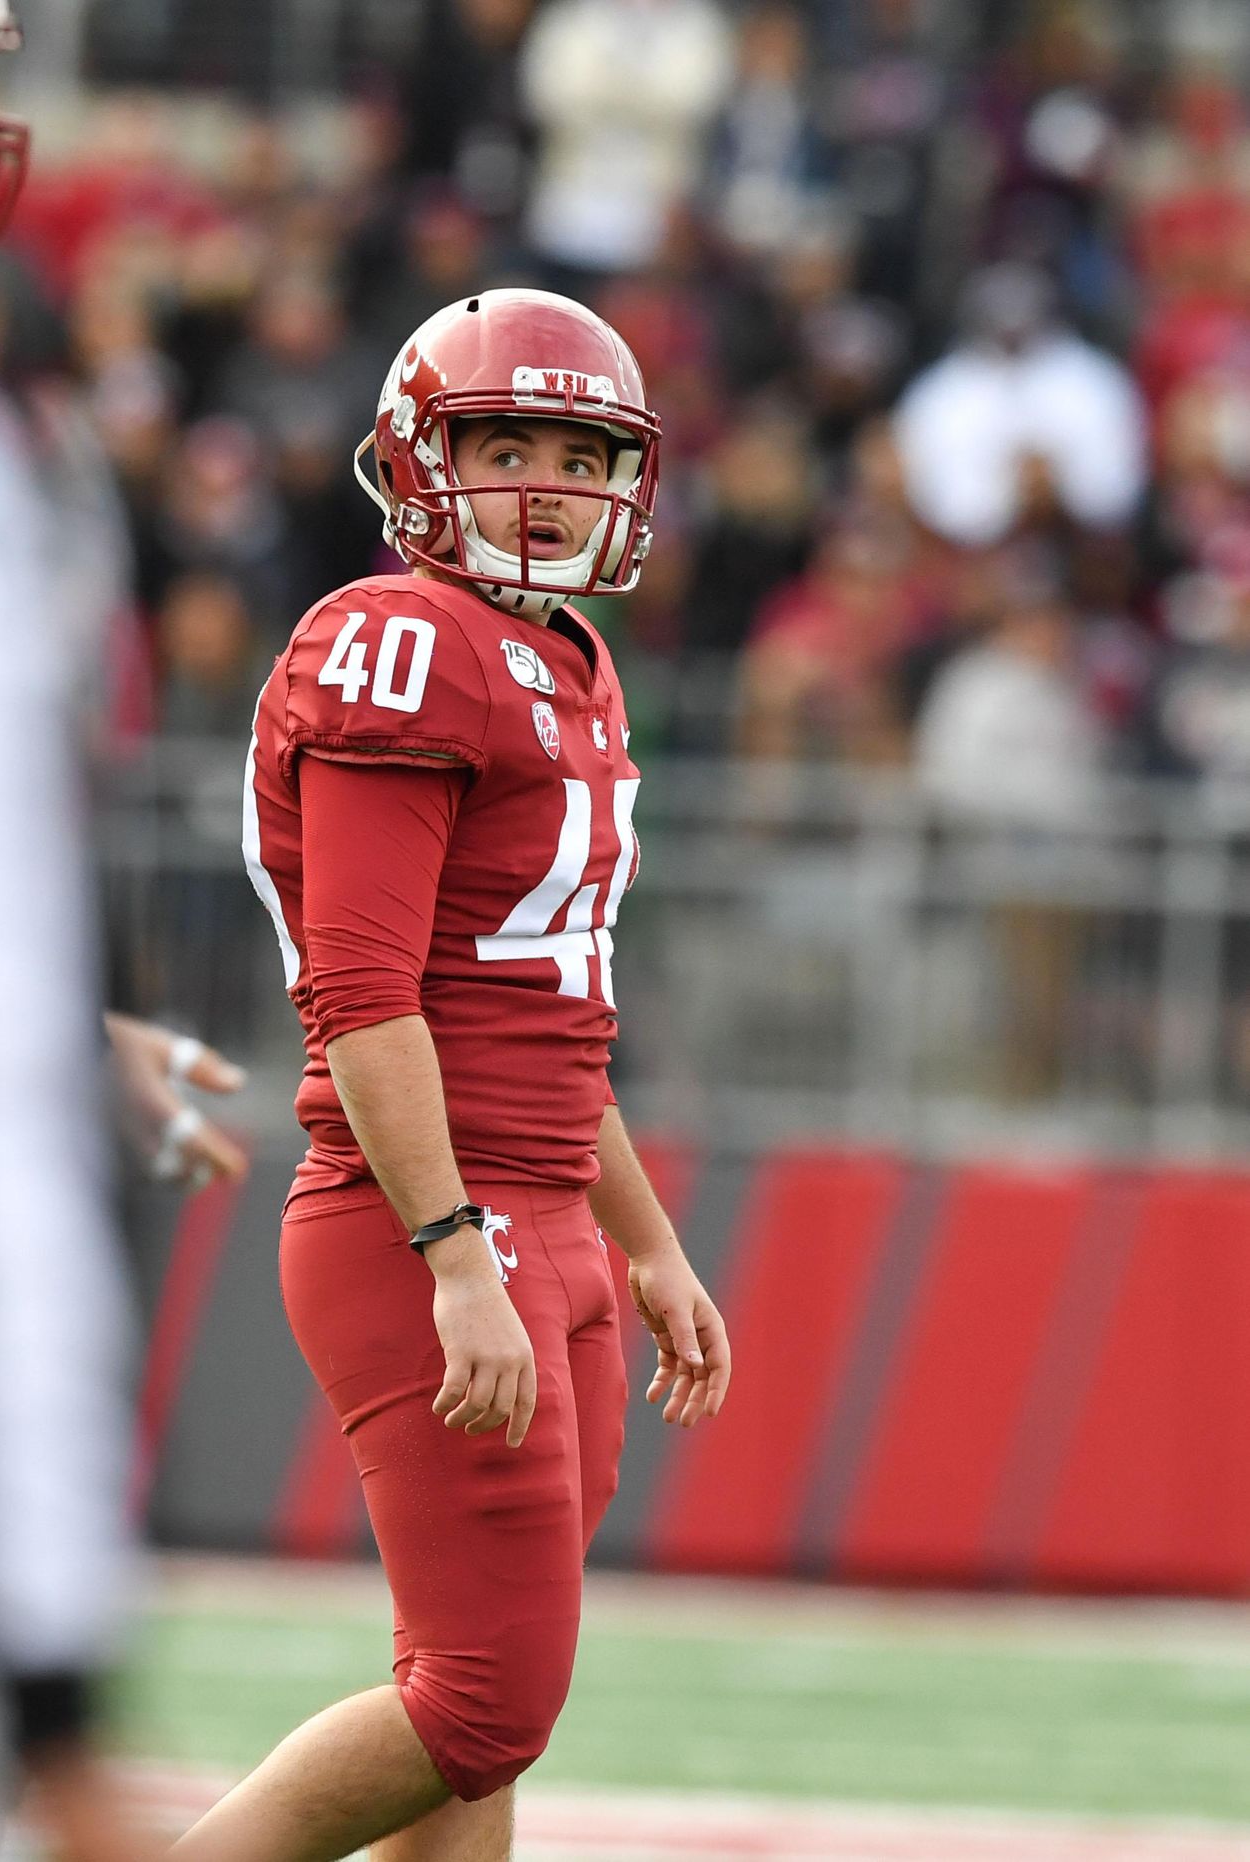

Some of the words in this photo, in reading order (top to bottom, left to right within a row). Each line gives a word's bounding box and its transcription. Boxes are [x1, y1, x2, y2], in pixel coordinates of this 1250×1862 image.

[542, 372, 588, 394] WSU
[318, 612, 436, 713] 40
[503, 640, 555, 692] 150
